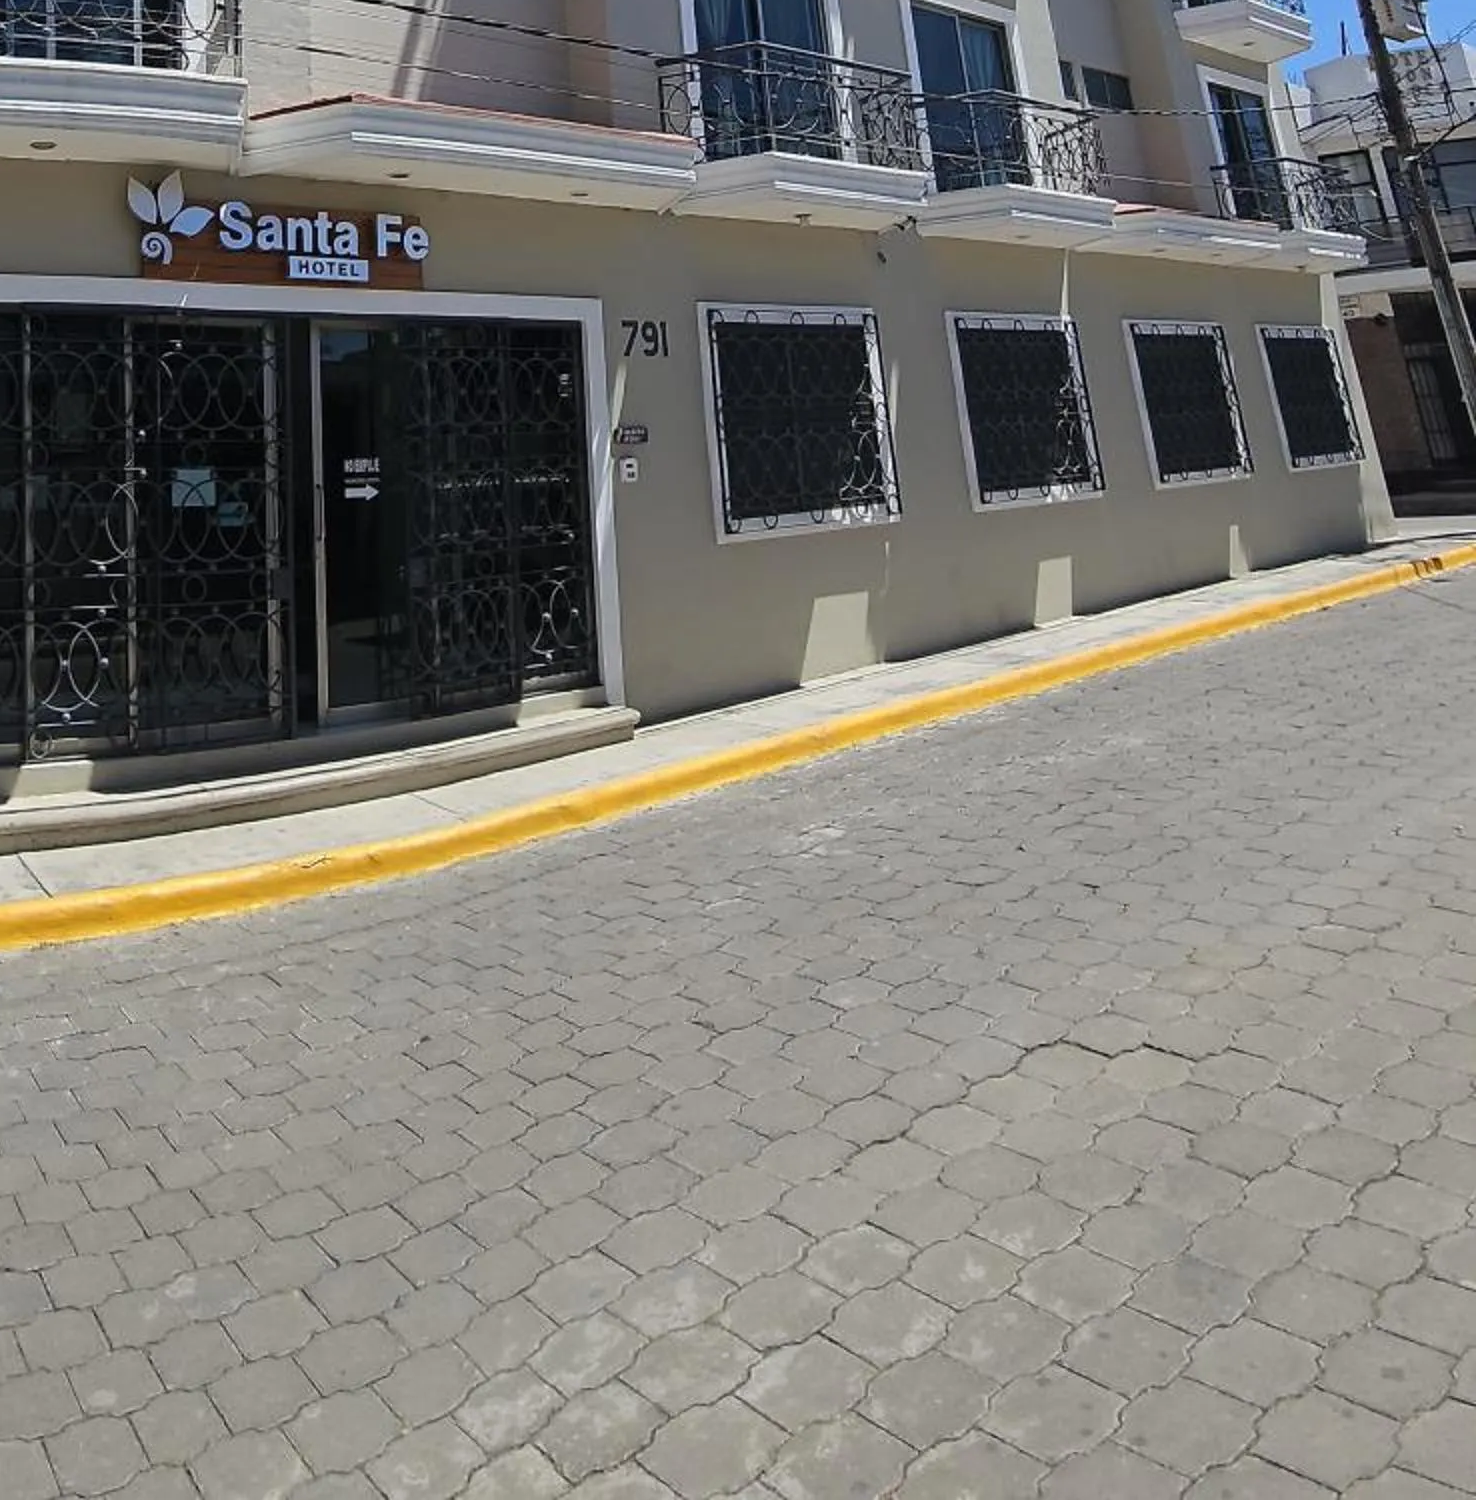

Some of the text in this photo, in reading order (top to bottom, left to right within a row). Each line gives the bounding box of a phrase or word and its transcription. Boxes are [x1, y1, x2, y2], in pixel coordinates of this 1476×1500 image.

[219, 201, 430, 261] Santa Fe
[298, 259, 360, 277] HOTEL
[621, 320, 669, 357] 791
